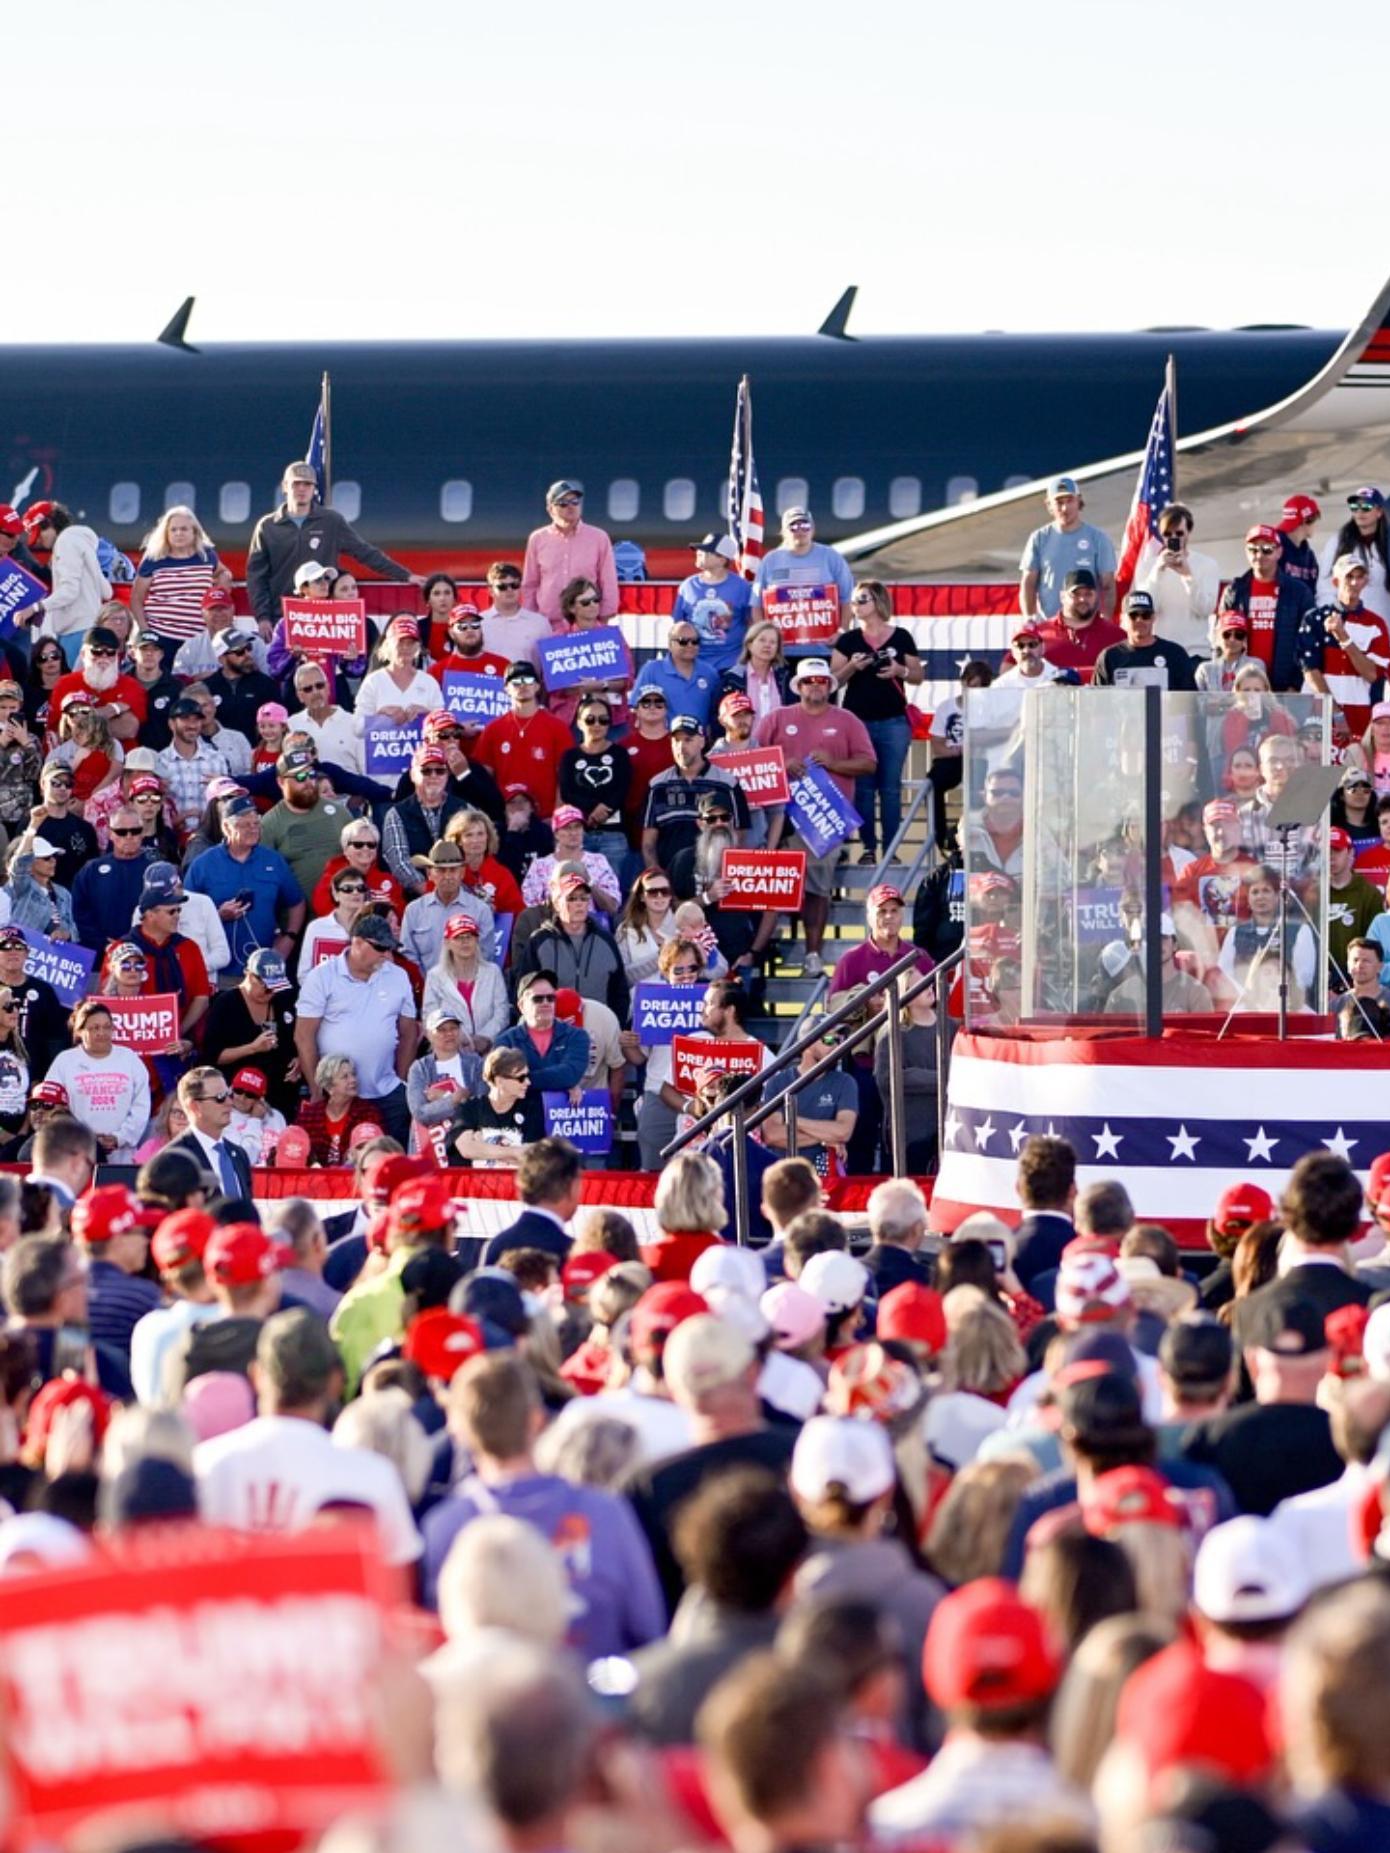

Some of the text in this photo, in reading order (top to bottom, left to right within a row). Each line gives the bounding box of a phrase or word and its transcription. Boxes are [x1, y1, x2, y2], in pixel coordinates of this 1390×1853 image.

[767, 600, 836, 615] DREAM BIG,
[288, 610, 362, 626] DREAM BIG,
[773, 613, 832, 630] AGAIN!
[291, 622, 356, 640] AGAIN!
[545, 641, 620, 662] DREAM BIG,
[551, 652, 617, 675] AGAIN!
[448, 686, 493, 700] DREAM
[448, 698, 513, 718] AGAIN
[370, 731, 415, 742] DREAM
[373, 742, 420, 758] AGA
[755, 762, 784, 777] BIG,
[740, 773, 778, 792] AIN!
[789, 780, 837, 840] AGAIN!
[802, 776, 847, 836] REAM BIG,
[727, 865, 800, 881] DREAM BIG,
[730, 879, 794, 895] AGAIN!
[1079, 904, 1121, 919] TRU
[1081, 919, 1116, 930] WILL
[60, 956, 87, 978] BIG,
[23, 960, 80, 992] GAIN!
[641, 1000, 694, 1013] DREAM
[111, 1010, 173, 1031] RUMP
[641, 1012, 704, 1029] AGAI
[134, 1028, 158, 1041] FIX
[160, 1026, 173, 1038] IT
[677, 1051, 758, 1072] DREAM BIG,
[549, 1106, 608, 1120] DREAM BIG,
[552, 1120, 604, 1137] AGAIN!
